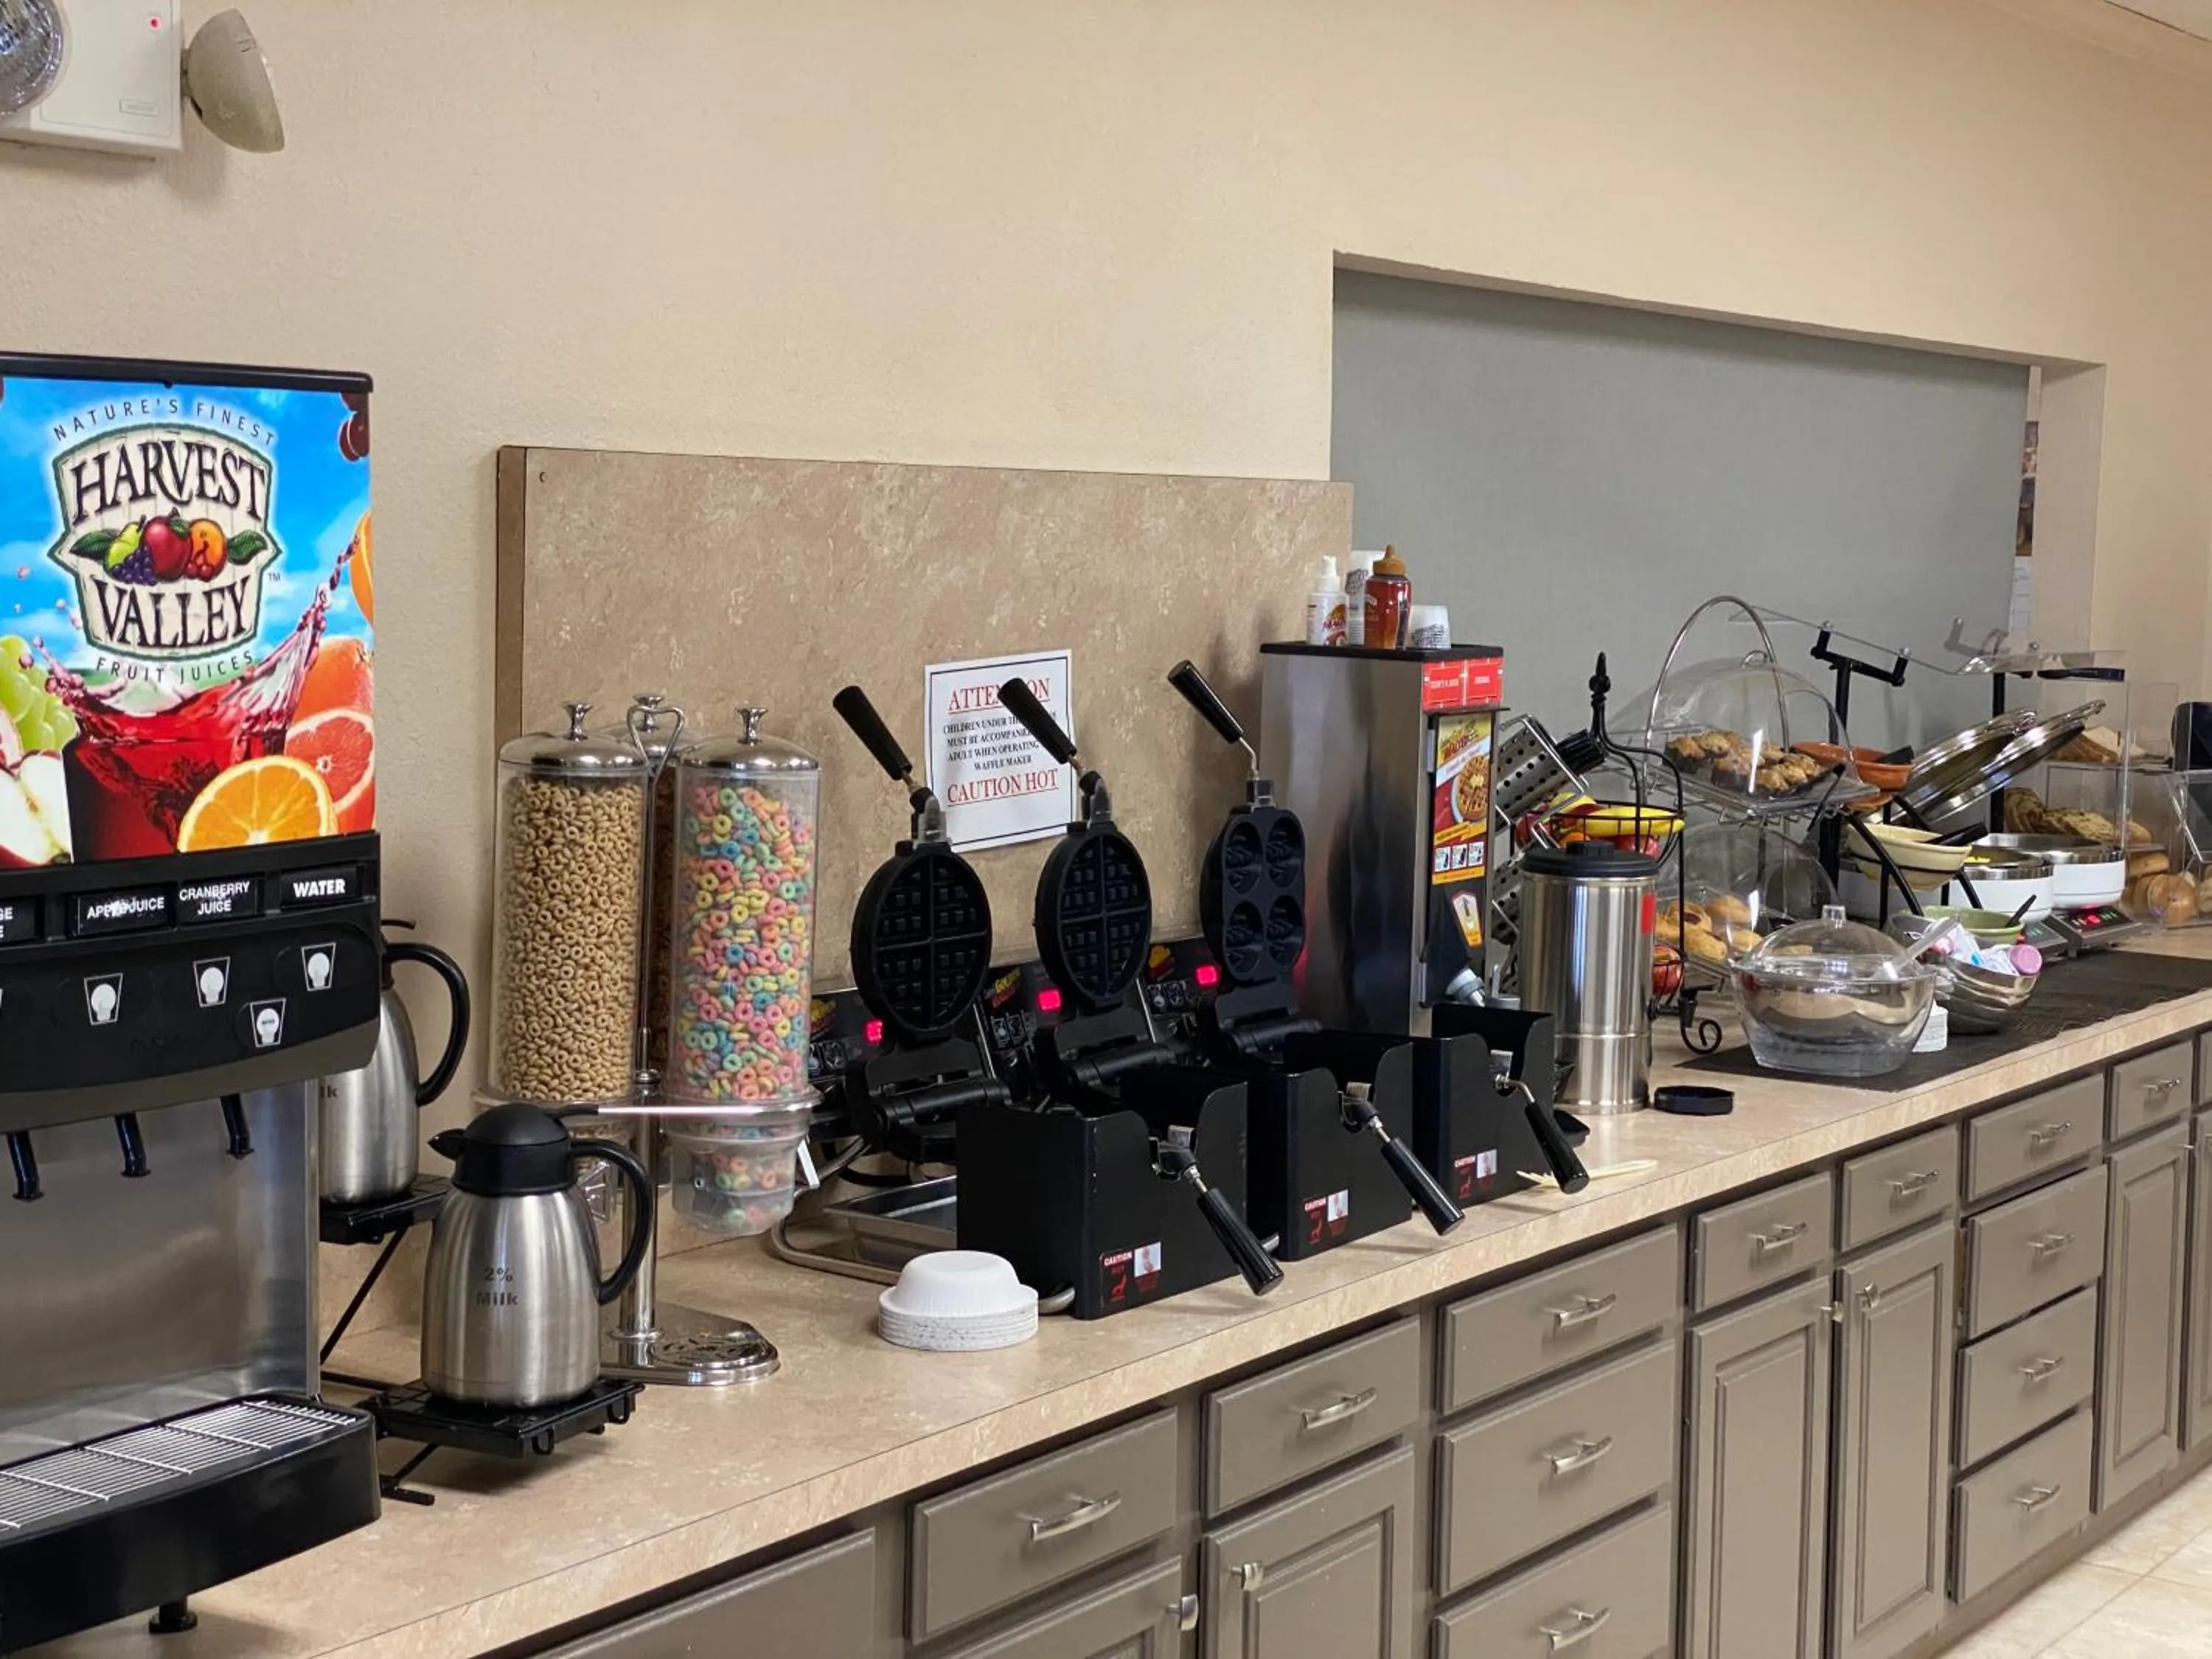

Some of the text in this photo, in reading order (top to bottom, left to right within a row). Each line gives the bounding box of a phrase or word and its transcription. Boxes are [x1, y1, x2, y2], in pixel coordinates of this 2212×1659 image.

[53, 398, 274, 445] NATURE'S FINEST
[70, 439, 266, 527] HARVEST
[90, 574, 251, 649] VALLEY
[96, 650, 253, 684] FRUIT JUICES
[948, 678, 1051, 711] ATTEON
[982, 717, 1007, 729] UNDER
[947, 737, 967, 748] MUST
[981, 727, 1032, 742] ACCOMPANIE
[974, 745, 998, 757] WHEN
[974, 754, 1032, 771] WAFFLE MAKER
[947, 768, 1059, 804] CAUTION HOT
[178, 880, 251, 901] CRANBERRY
[293, 878, 347, 897] WATER
[129, 897, 164, 914] JUICE
[197, 900, 232, 915] JUICE
[484, 1266, 513, 1282] 2%
[476, 1291, 518, 1307] Milk
